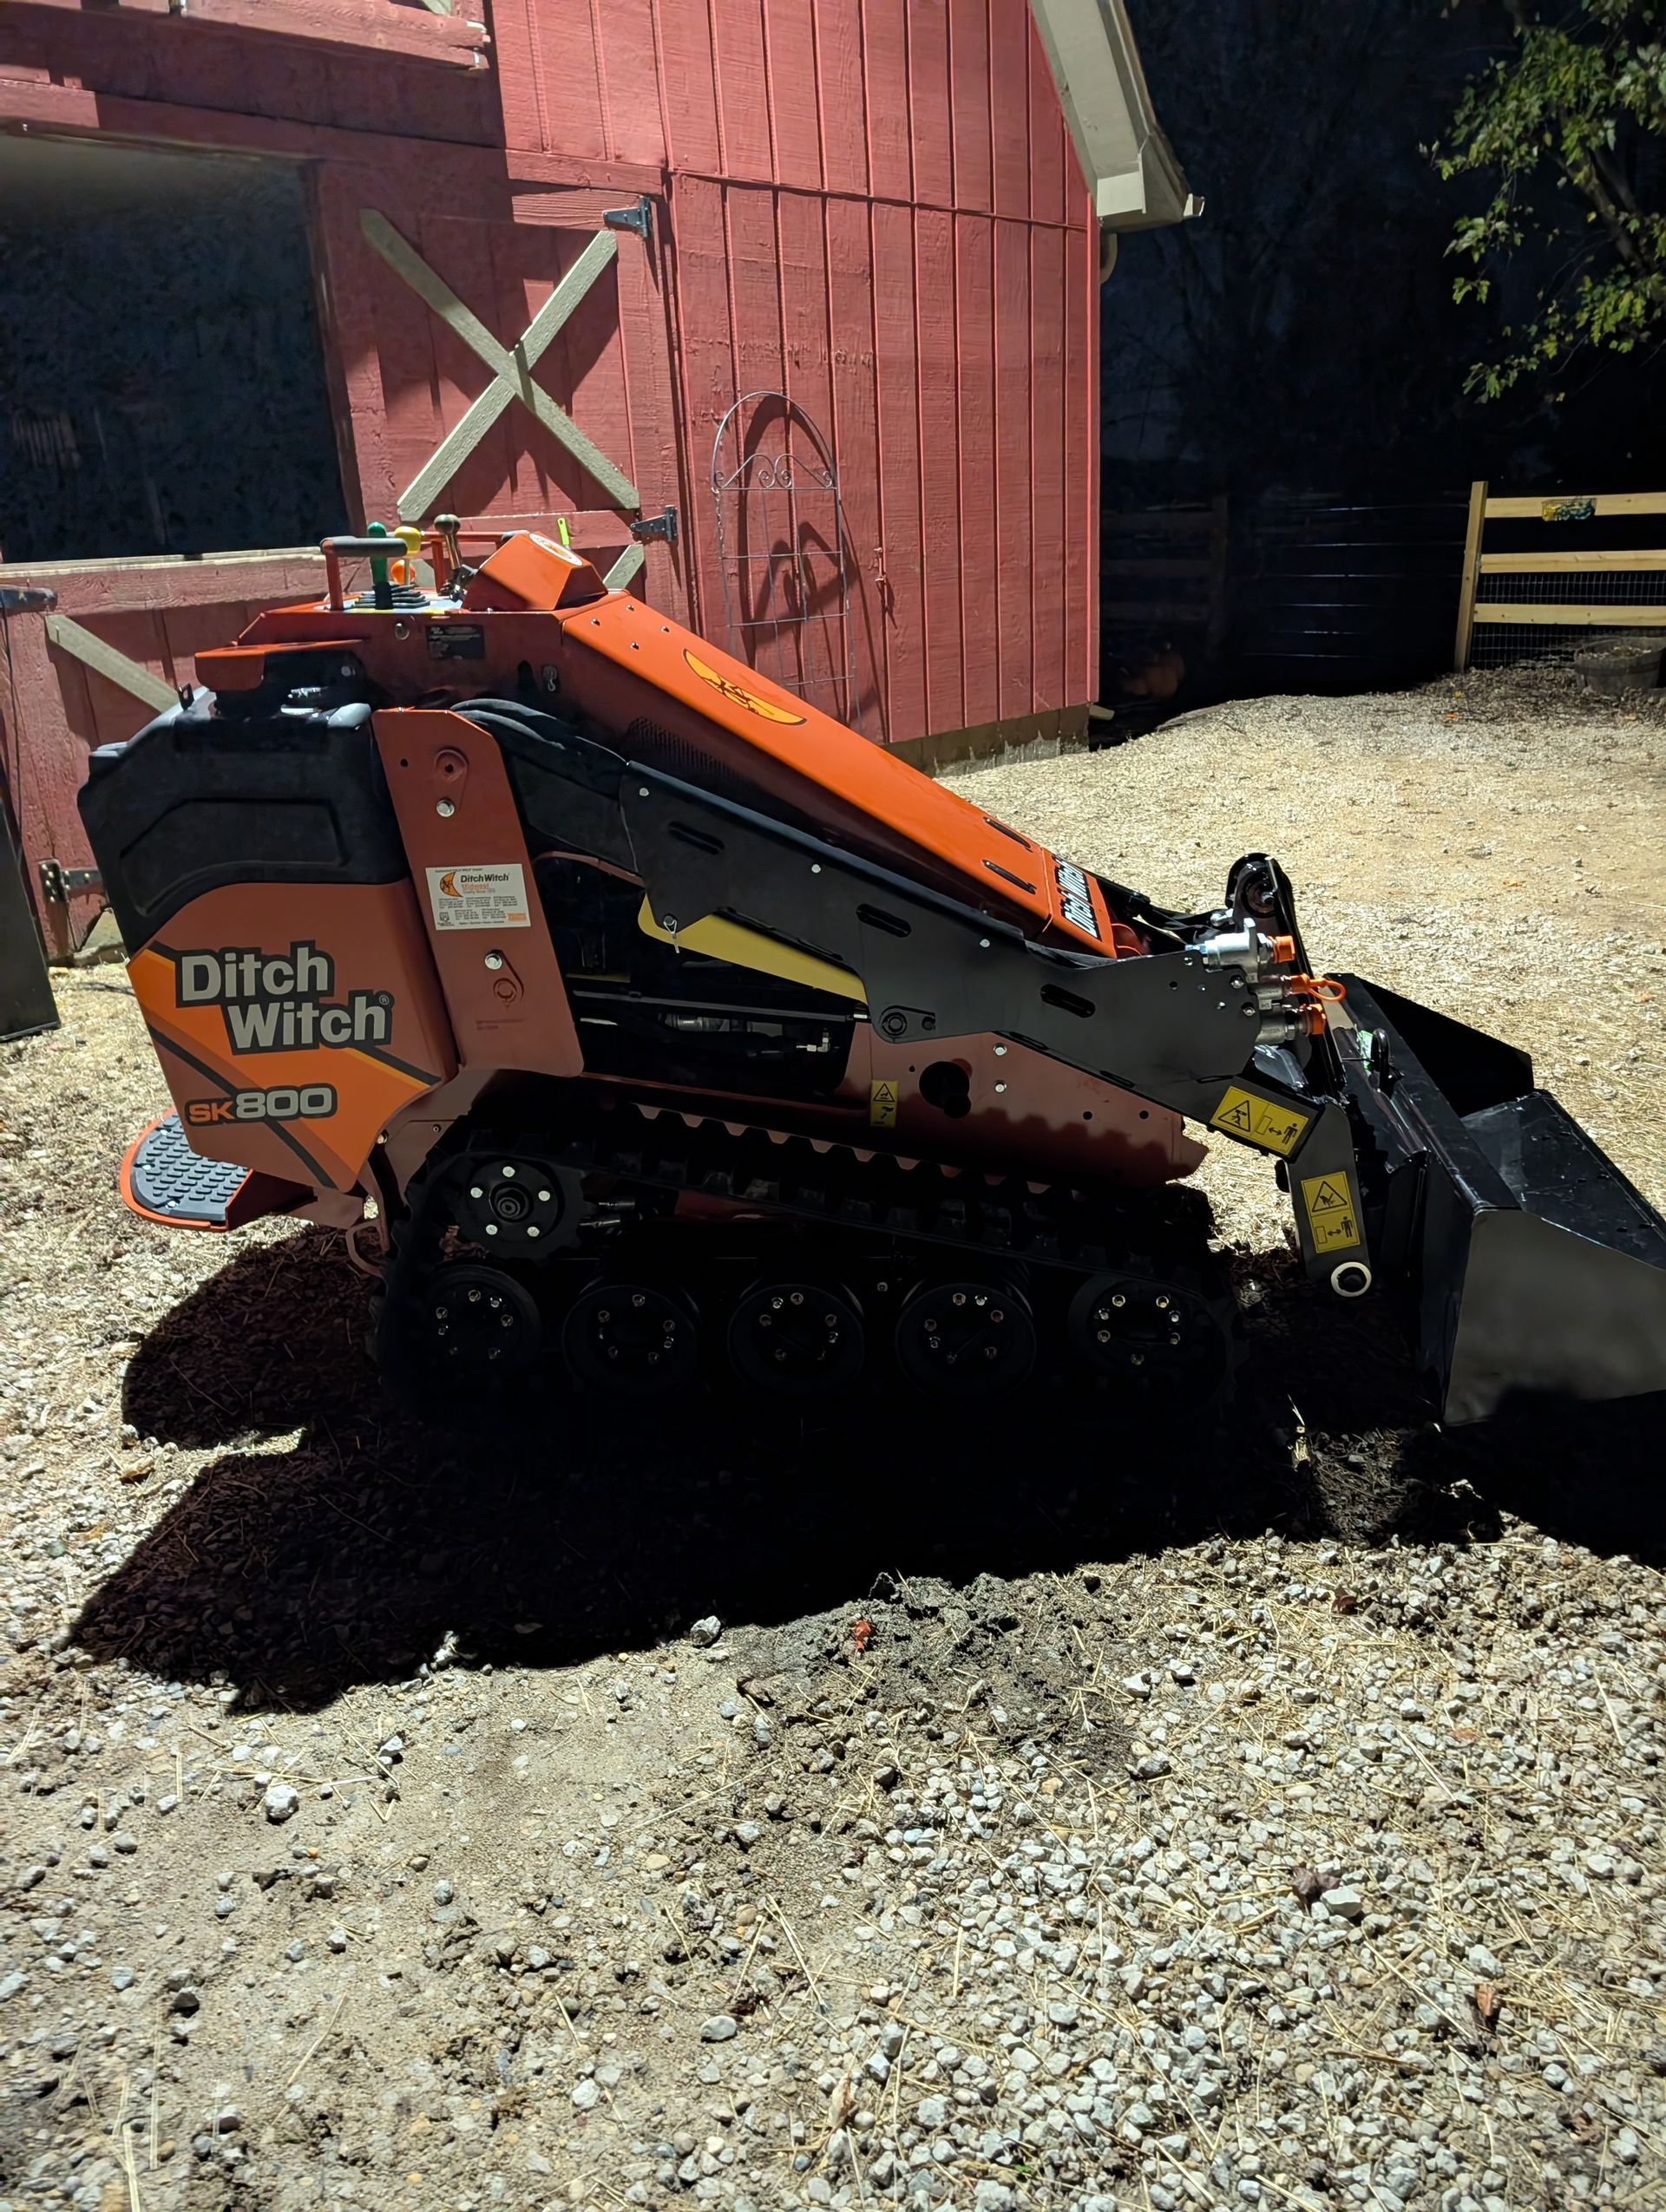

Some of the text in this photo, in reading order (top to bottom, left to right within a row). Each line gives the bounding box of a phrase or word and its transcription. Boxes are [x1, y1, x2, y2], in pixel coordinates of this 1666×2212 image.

[1060, 891, 1098, 938] Ditch
[181, 946, 329, 1002] Ditch
[189, 1087, 332, 1122] SK800
